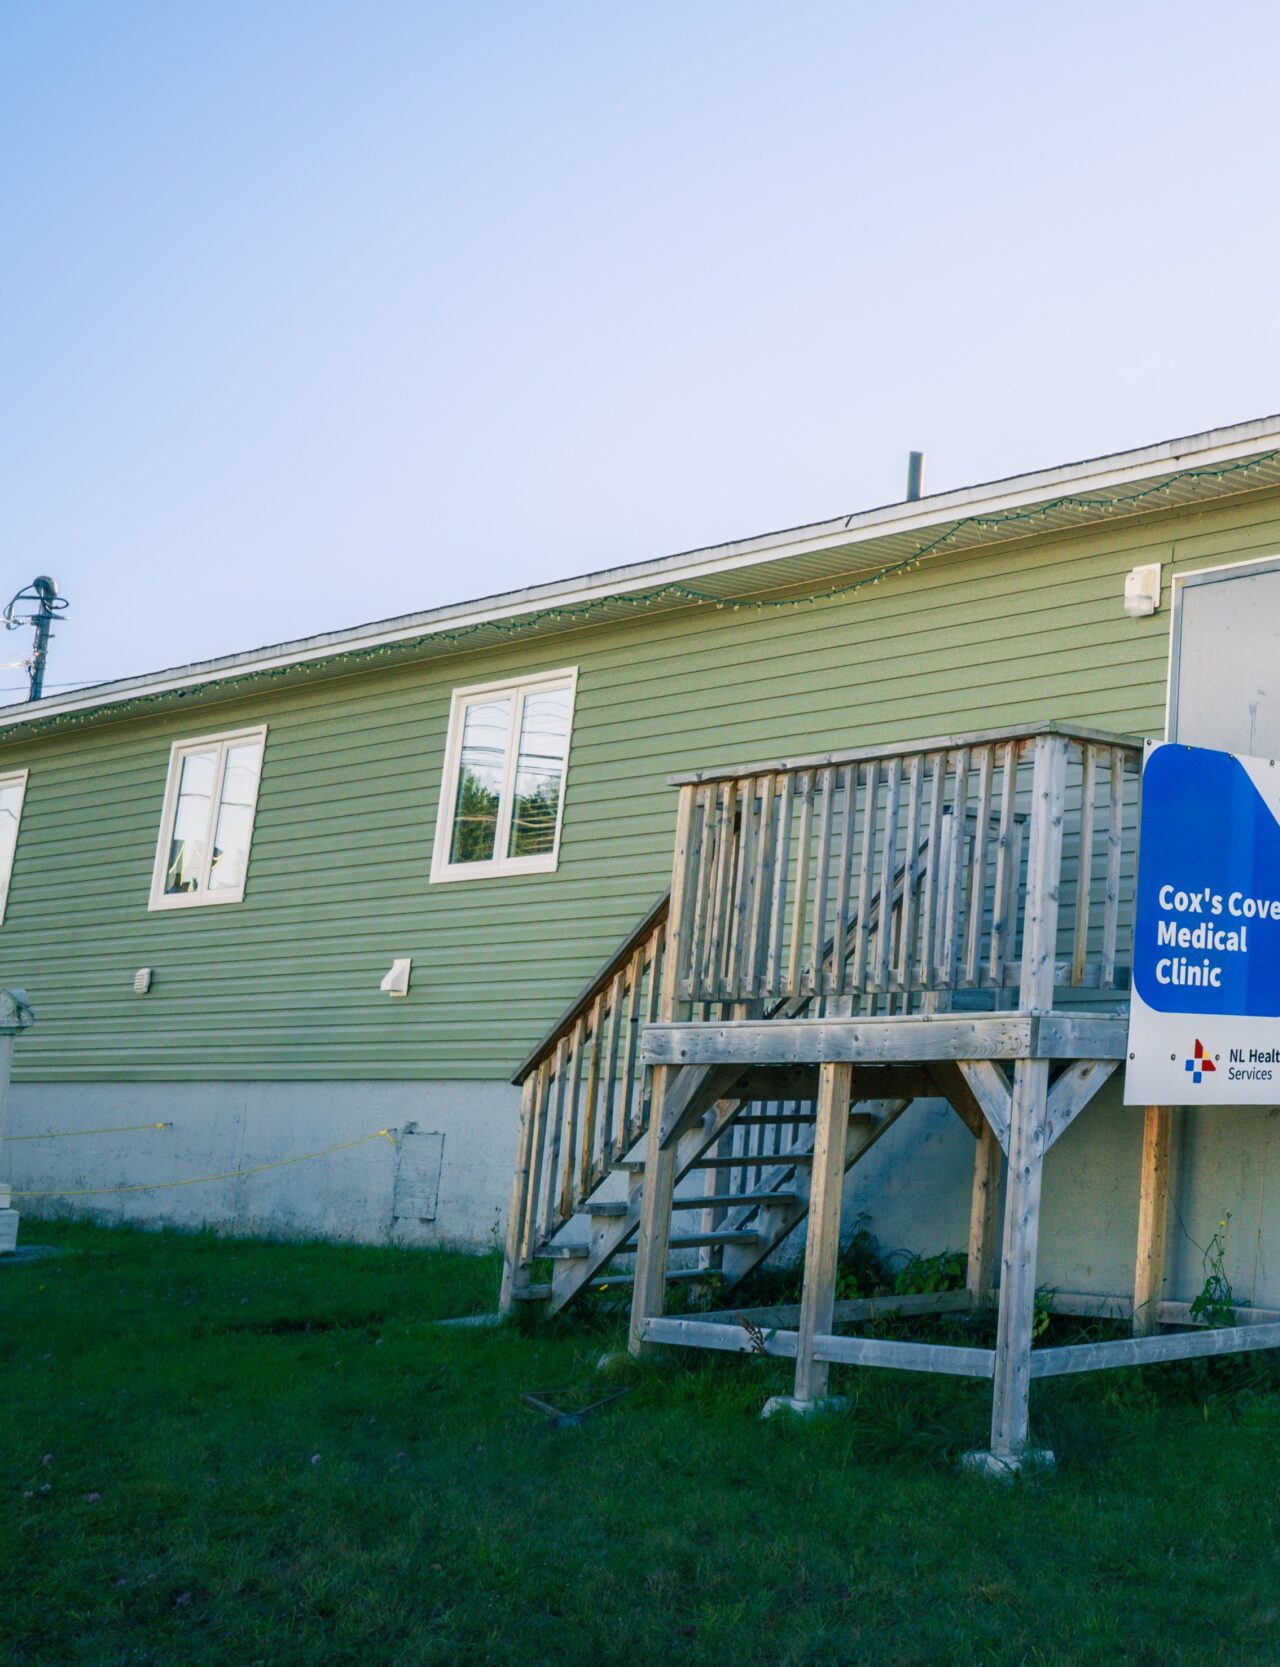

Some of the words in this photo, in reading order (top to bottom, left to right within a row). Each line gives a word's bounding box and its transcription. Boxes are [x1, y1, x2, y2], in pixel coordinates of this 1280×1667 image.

[1158, 885, 1223, 915] Cox's
[1157, 920, 1248, 952] Medical
[1155, 958, 1222, 988] Clinic
[1229, 1048, 1246, 1064] NL
[1228, 1067, 1273, 1081] Services
